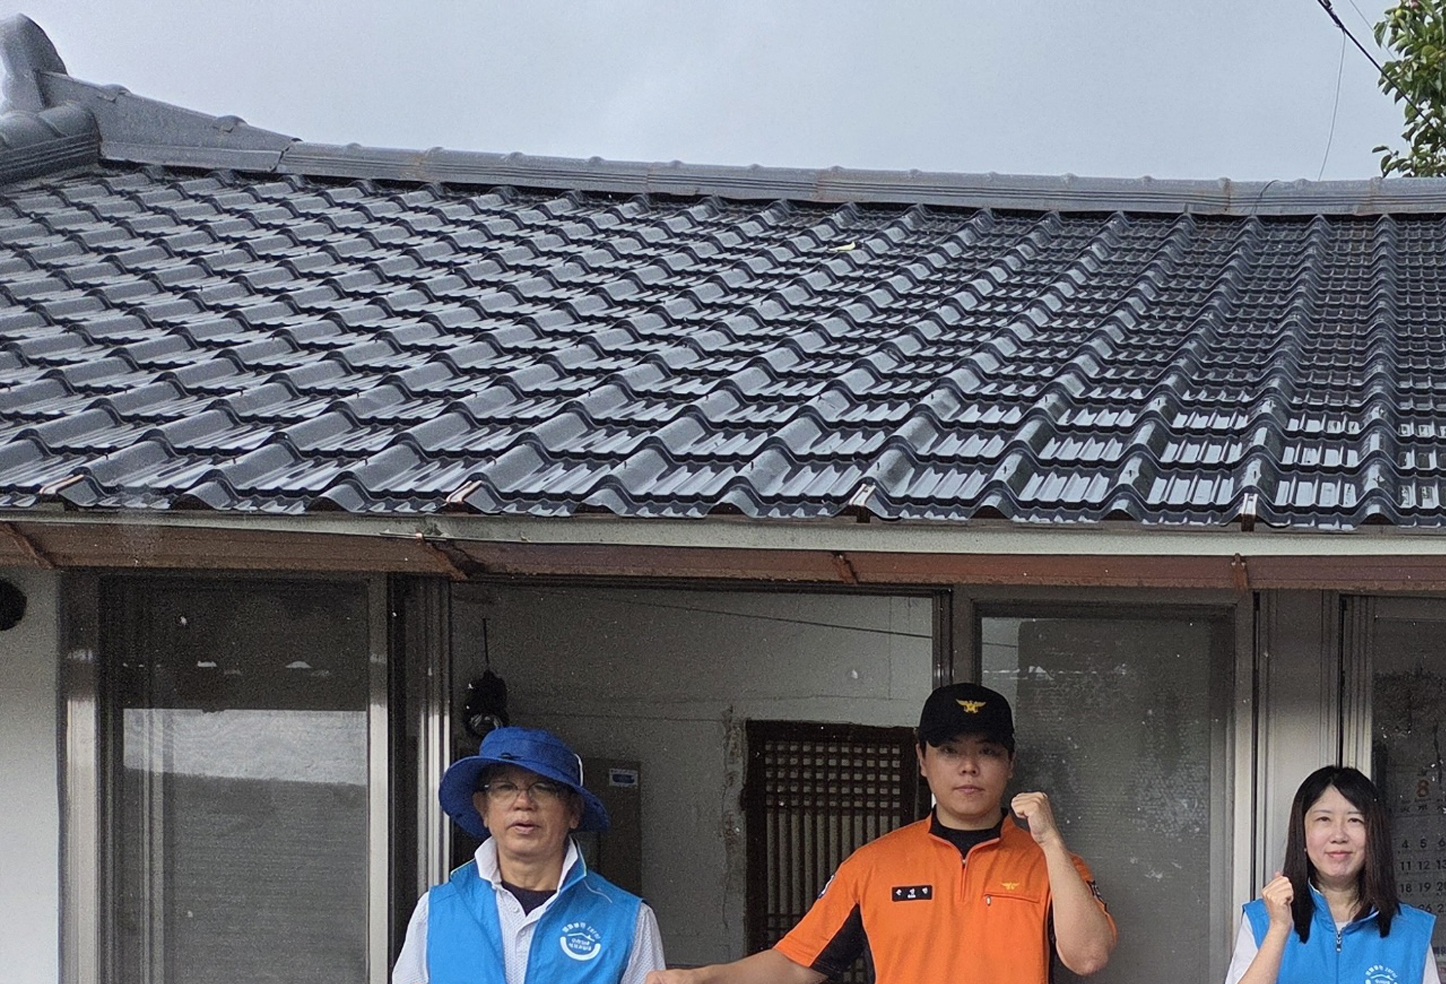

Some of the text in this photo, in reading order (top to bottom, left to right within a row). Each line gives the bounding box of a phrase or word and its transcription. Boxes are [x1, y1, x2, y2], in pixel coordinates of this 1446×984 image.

[1417, 780, 1429, 797] 8
[1402, 839, 1409, 849] 4
[1420, 838, 1427, 848] 5
[1438, 837, 1446, 847] 6
[1401, 861, 1411, 871] 11
[1418, 860, 1430, 870] 12
[1400, 883, 1412, 893] 18
[1419, 882, 1431, 892] 19
